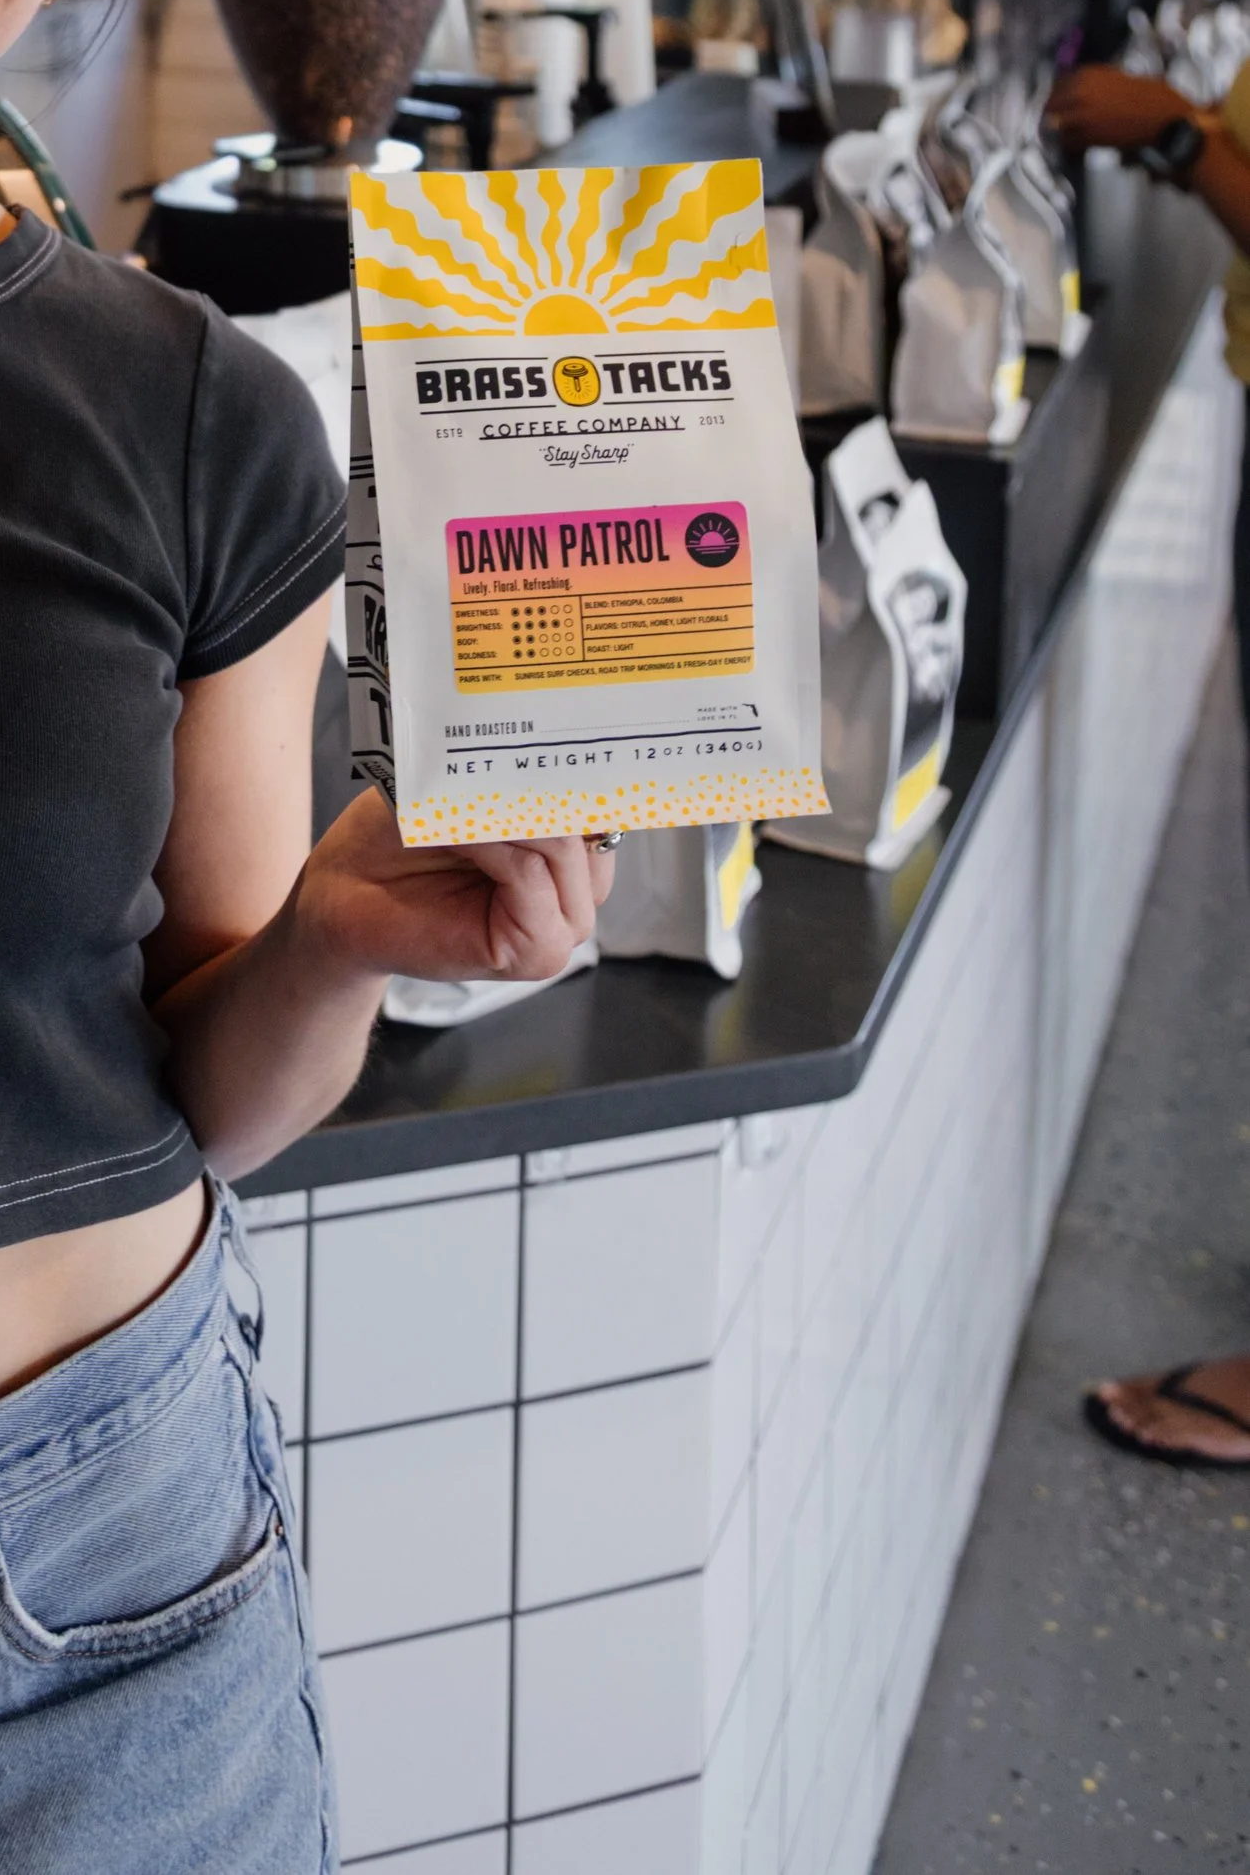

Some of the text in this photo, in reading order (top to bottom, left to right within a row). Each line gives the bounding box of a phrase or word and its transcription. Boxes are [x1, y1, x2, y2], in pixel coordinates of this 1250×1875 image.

[415, 359, 731, 404] BRASS TACKS
[482, 420, 567, 439] COFFEE
[577, 415, 682, 434] COMPANY
[699, 415, 725, 426] 2013
[456, 518, 670, 575] DAWN PATROL
[463, 576, 572, 596] Lively. Floral. Refreshing.
[584, 596, 684, 610] BLEND: ETHIOPIA, COLOMBIA
[455, 608, 500, 618] SWEETNESS:
[456, 622, 503, 632] BRIGHTNESS:
[586, 614, 729, 632] FLAVORS: CITRUS, HONEY, LIGHT FLORALS
[457, 638, 478, 646] BODY:
[587, 642, 635, 654] ROAST: LIGHT
[458, 651, 498, 660] BOLDNESS:
[459, 675, 481, 684] PAIRS
[482, 674, 503, 682] WITH:
[514, 671, 546, 681] SUNRISE
[547, 670, 565, 678] SURF
[567, 667, 597, 677] CHECKS,
[598, 666, 618, 675] ROAD
[620, 665, 636, 673] TRIP
[637, 662, 675, 671] MORNINGS
[684, 658, 723, 668] FRESH-DAY
[724, 655, 752, 666] ENERGY
[445, 720, 534, 738] HAND ROASTED ON
[447, 760, 493, 775] NET
[516, 751, 613, 770] WEIGHT
